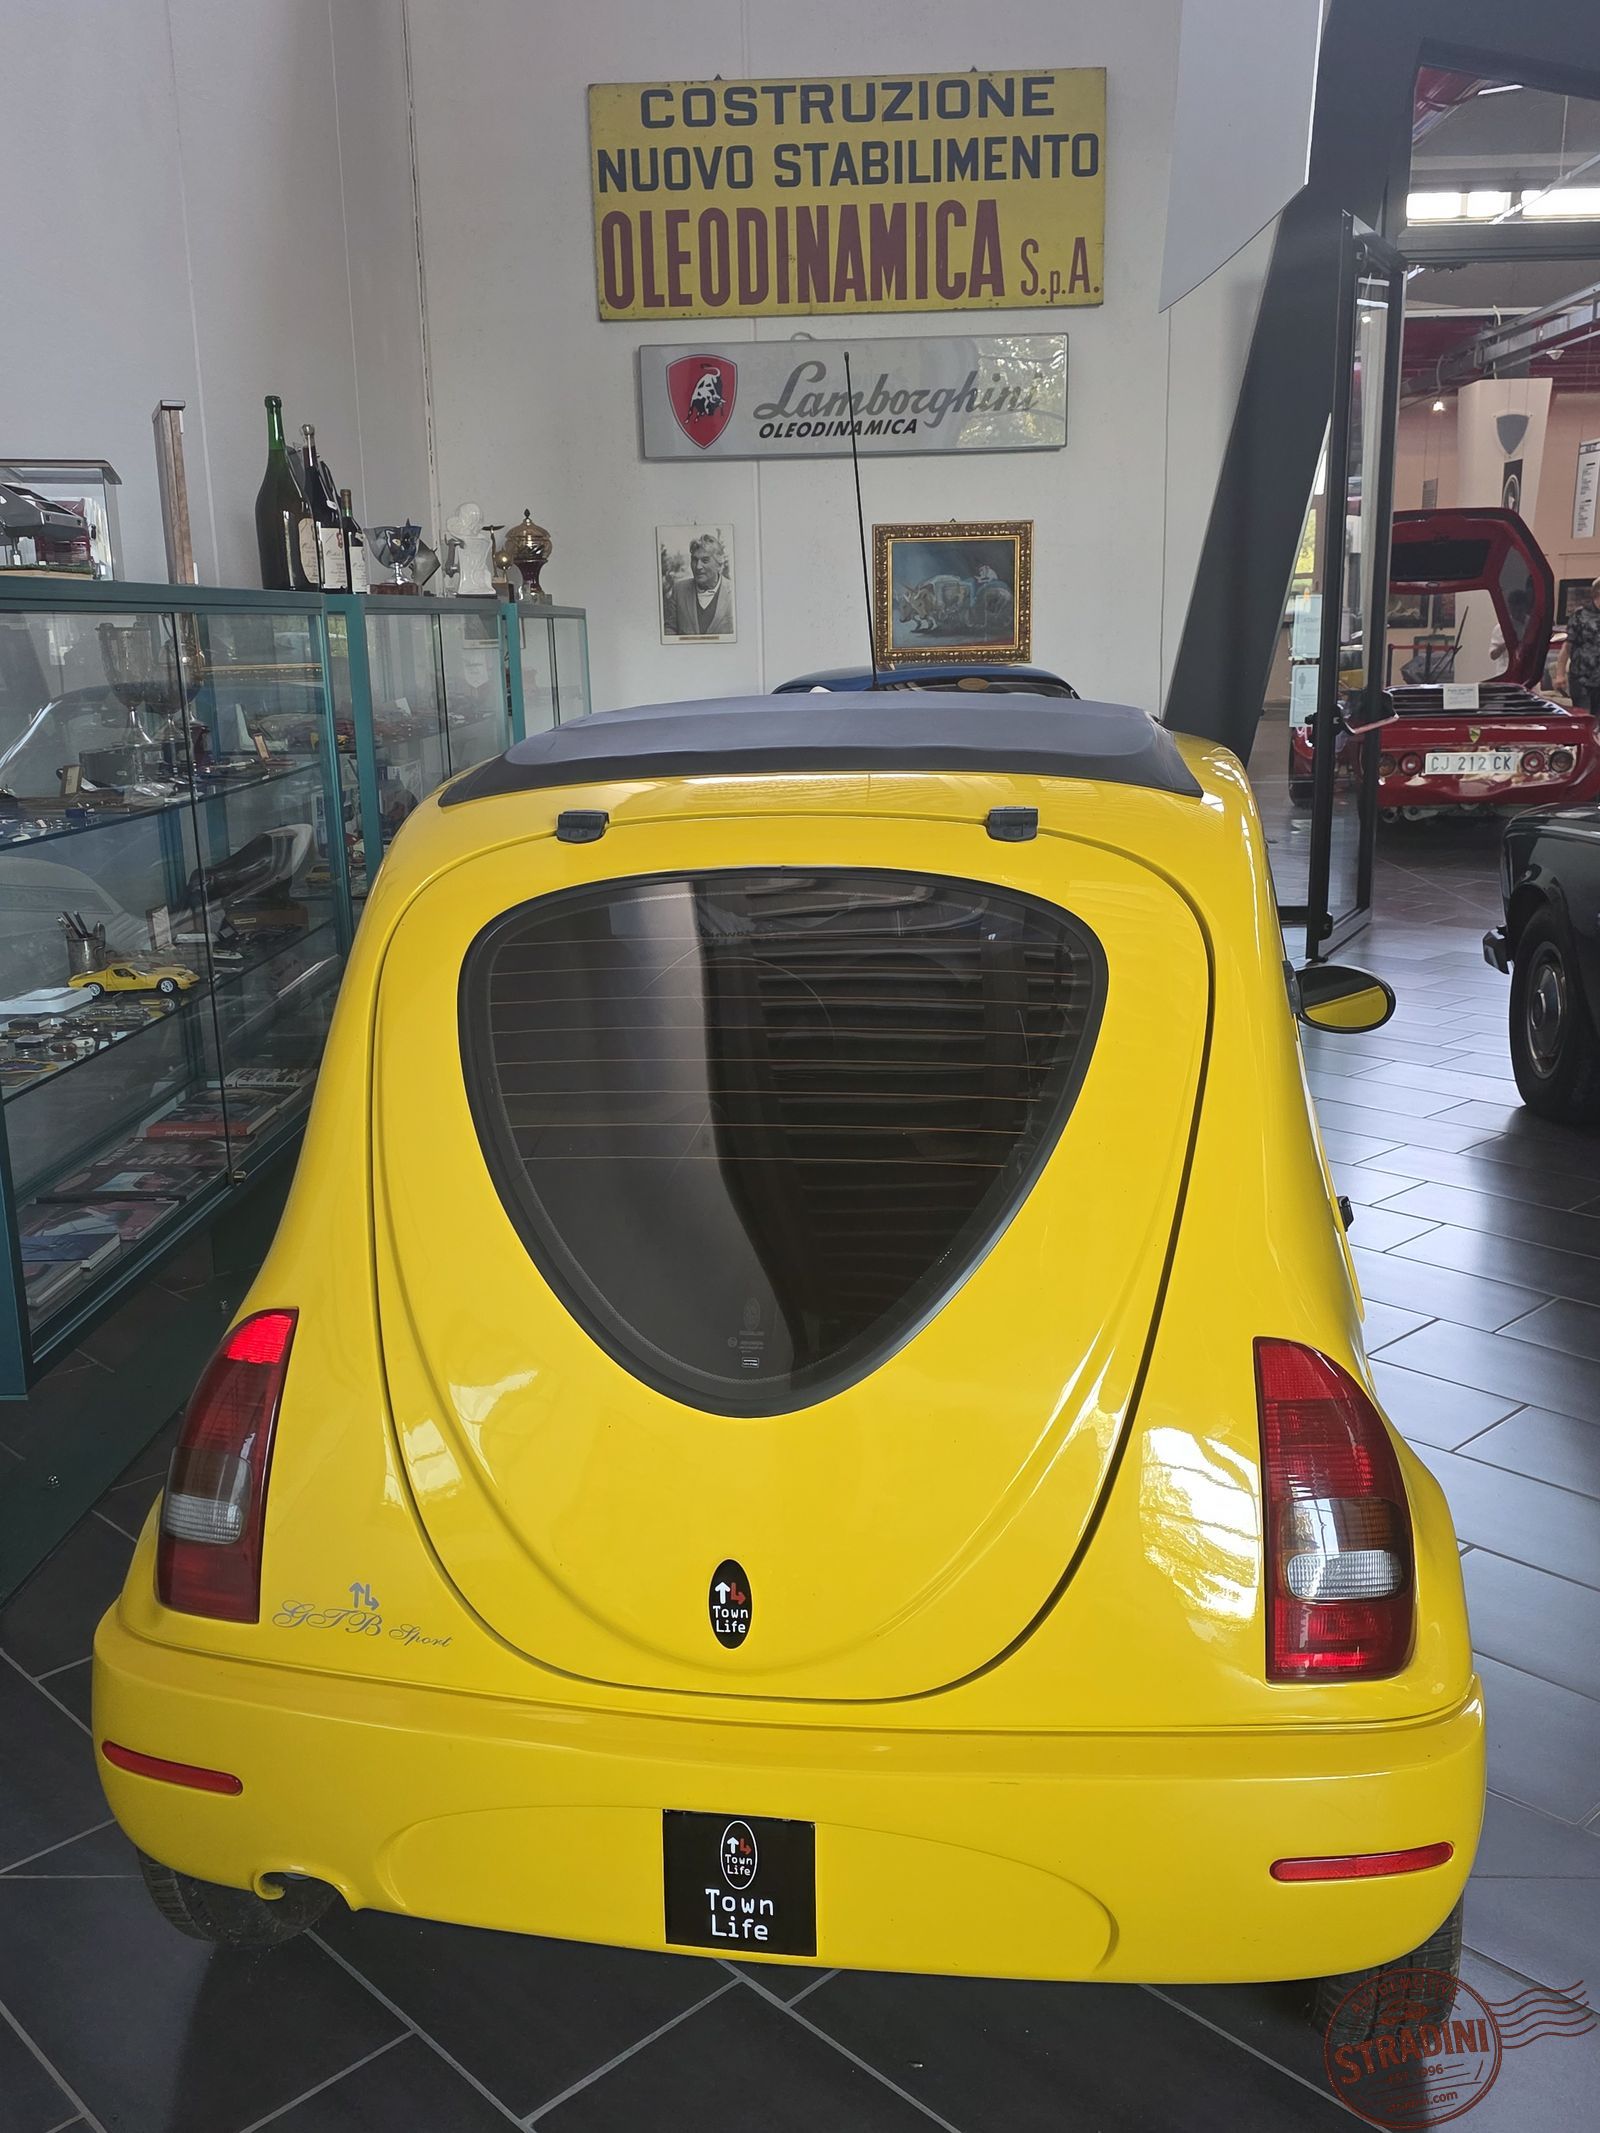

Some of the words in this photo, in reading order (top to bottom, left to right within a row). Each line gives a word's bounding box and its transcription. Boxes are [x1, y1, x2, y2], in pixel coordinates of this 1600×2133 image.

[640, 76, 1055, 129] COSTRUZIONE
[597, 144, 754, 193] NUOVO
[774, 132, 1100, 188] STABILIMENTO
[601, 198, 1006, 310] OLEODINAMICA
[1020, 236, 1100, 302] S.p.A.
[753, 360, 1043, 428] Lamborghini
[759, 418, 918, 438] OLEODINAMICA
[1431, 756, 1449, 771] CJ
[1458, 756, 1486, 771] 212
[1493, 756, 1512, 771] CK
[272, 1599, 383, 1637] GTB
[388, 1623, 453, 1648] Sport
[712, 1605, 749, 1619] Town
[716, 1619, 746, 1633] Life
[725, 1853, 753, 1866] Town
[727, 1864, 751, 1876] Life
[705, 1888, 774, 1916] Town
[711, 1914, 768, 1941] Life
